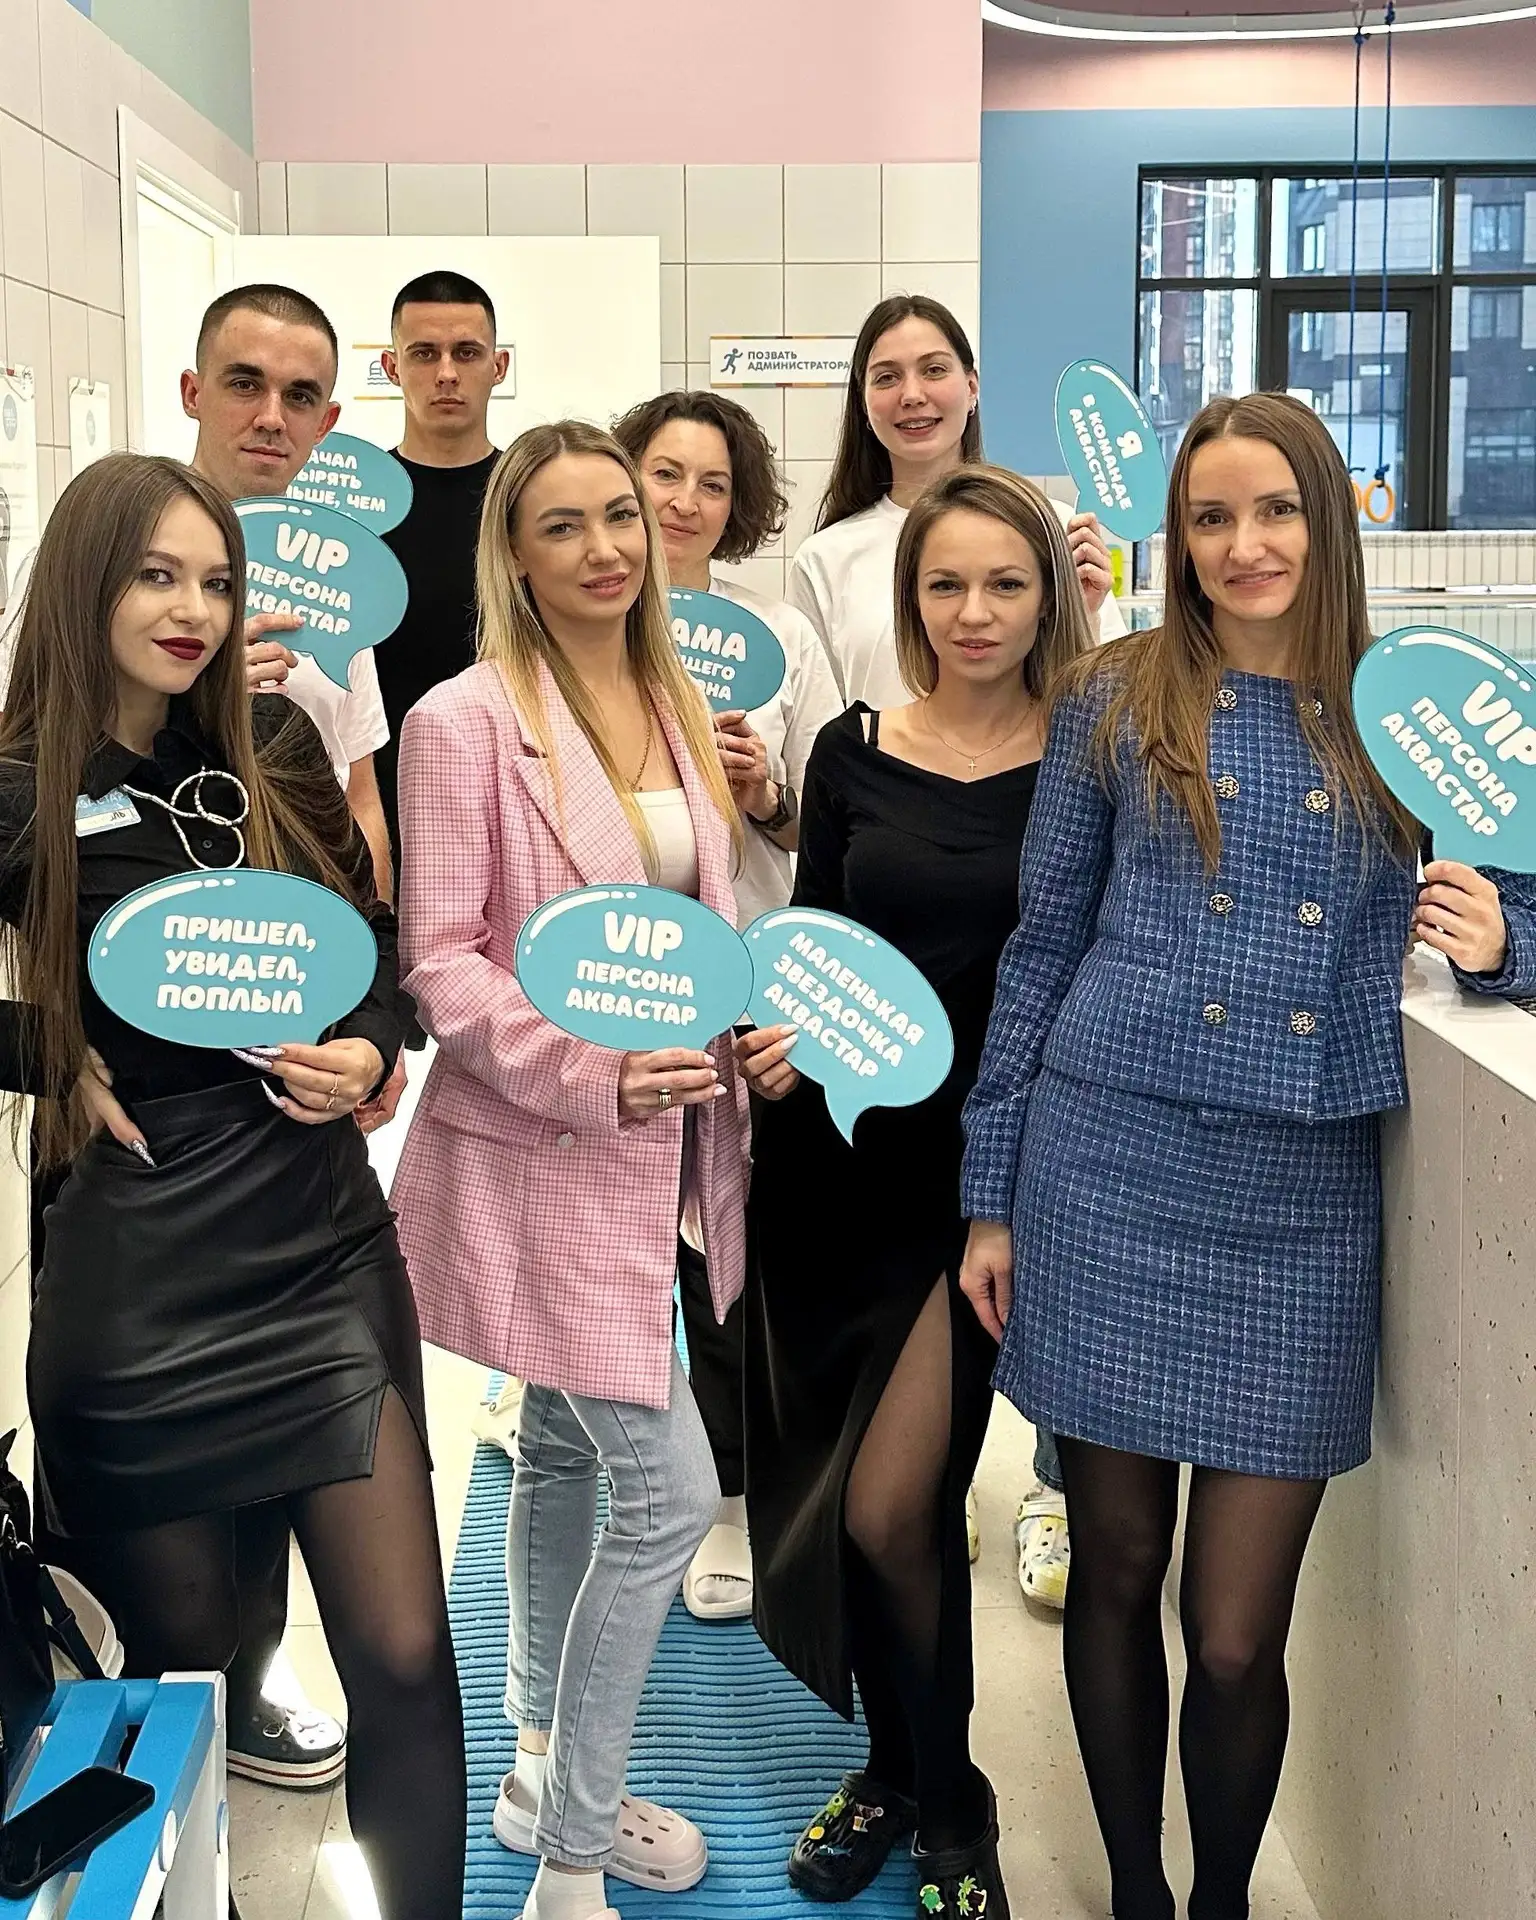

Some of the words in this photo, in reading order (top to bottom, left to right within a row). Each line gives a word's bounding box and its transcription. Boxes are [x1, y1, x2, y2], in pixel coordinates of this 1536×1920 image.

[747, 361, 851, 371] АДМИНИСТРАТОРА
[748, 351, 797, 360] ПОЗВАТЬ
[1082, 393, 1096, 408] В
[307, 449, 358, 470] АЧАЛ
[1069, 408, 1114, 508] АКВАСТАР
[1088, 411, 1133, 511] КОМАНДЕ
[1116, 430, 1143, 459] Я
[294, 468, 362, 490] ЫРЯТЬ
[346, 493, 386, 513] ЧЕМ
[276, 522, 349, 574] VIP
[246, 560, 351, 611] ПЕРСОНА
[246, 588, 351, 635] КВАСТАР
[671, 617, 747, 662] АМА
[1462, 680, 1536, 766] VIP
[1380, 712, 1499, 836] АКВАСТАР
[1411, 696, 1518, 817] ПЕРСОНА
[163, 914, 317, 953] ПРИШЕЛ,
[604, 910, 684, 961] VIP
[165, 949, 307, 986] УВИДЕЛ,
[576, 959, 695, 998] ПЕРСОНА
[788, 930, 926, 1046] МАЛЕНЬКАЯ
[156, 984, 303, 1015] ПОПЛЫЛ
[565, 987, 698, 1027] АКВАСТАР
[772, 953, 904, 1068] ЗВЕЗДОЧКА
[763, 982, 879, 1077] АКВАСТАР
